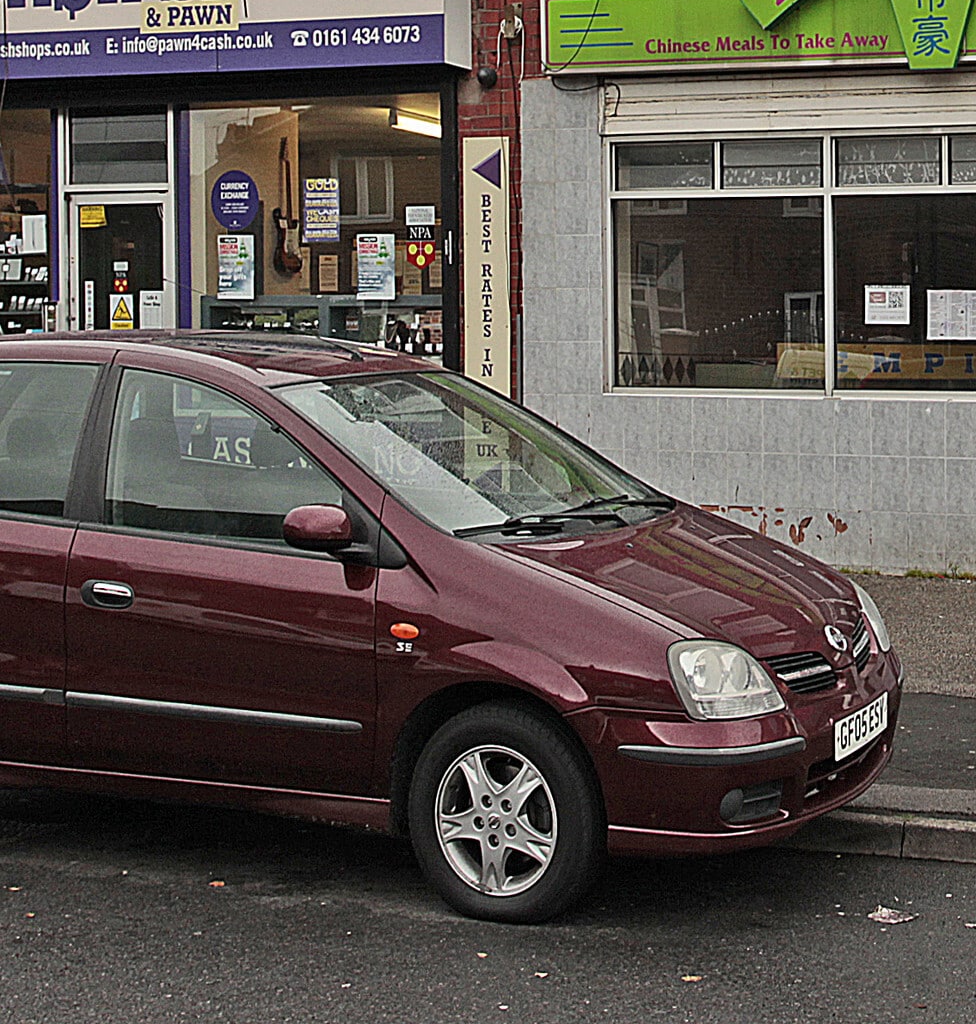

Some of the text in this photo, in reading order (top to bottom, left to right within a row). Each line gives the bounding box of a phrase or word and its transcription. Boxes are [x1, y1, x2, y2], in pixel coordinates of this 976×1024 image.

[146, 5, 233, 27] & PAWN
[106, 38, 119, 54] E:
[122, 31, 273, 56] info@pawn4cash.co.uk
[312, 25, 421, 47] 0161 434 6073
[645, 32, 888, 54] Chinese Meals To Take Away
[306, 178, 338, 191] GOLD
[409, 226, 432, 239] NPA
[481, 194, 492, 253] BEST
[481, 264, 493, 338] RATES
[481, 348, 493, 377] IN
[840, 695, 885, 750] GF05 ESY
